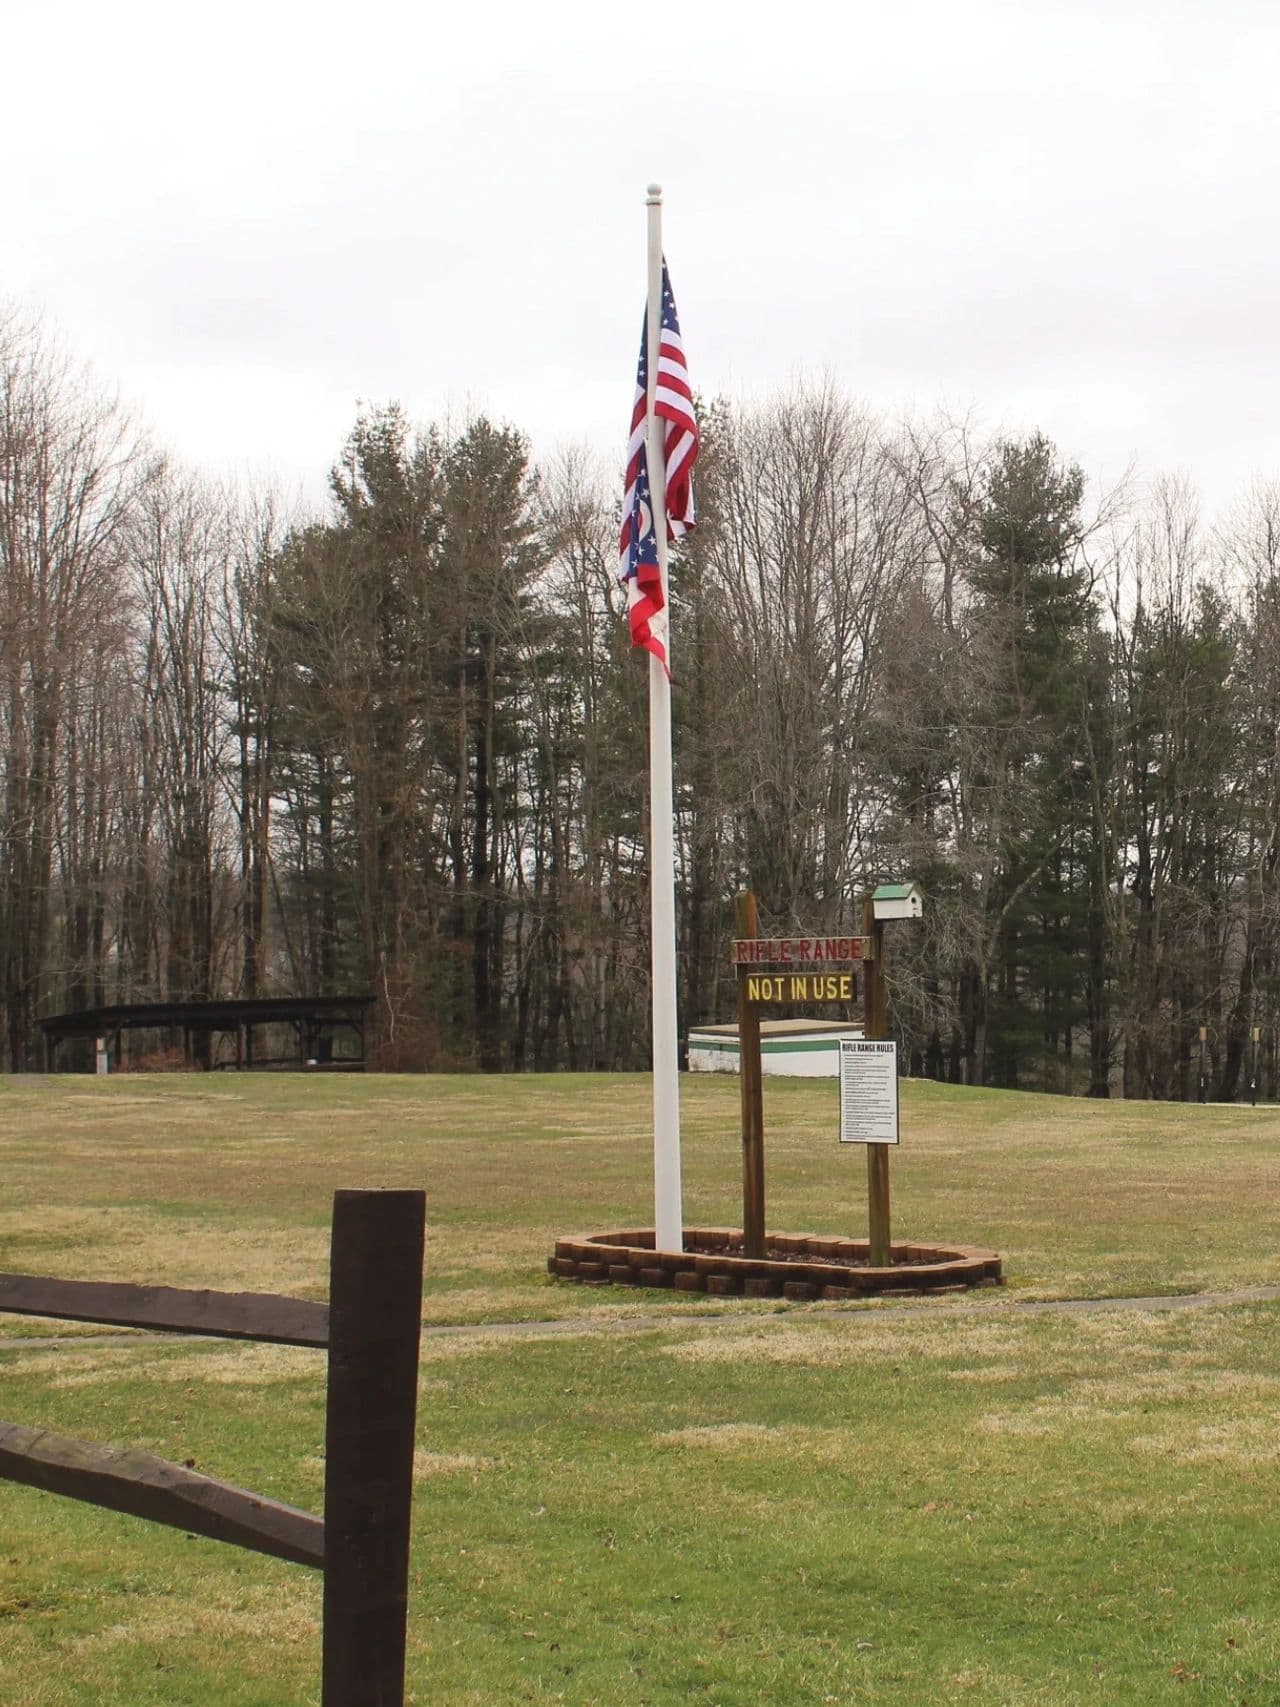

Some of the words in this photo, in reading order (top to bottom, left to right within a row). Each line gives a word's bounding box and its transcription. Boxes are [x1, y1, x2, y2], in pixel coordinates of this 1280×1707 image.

[736, 941, 791, 961] RIFLE
[799, 938, 863, 960] RANGE
[748, 977, 784, 1001] NOT
[791, 977, 807, 1000] IN
[813, 976, 852, 1000] USE
[842, 1043, 856, 1052] RIFLE
[857, 1043, 876, 1053] RANGE
[877, 1043, 894, 1053] RULES
[1250, 1078, 1256, 1088] 2
